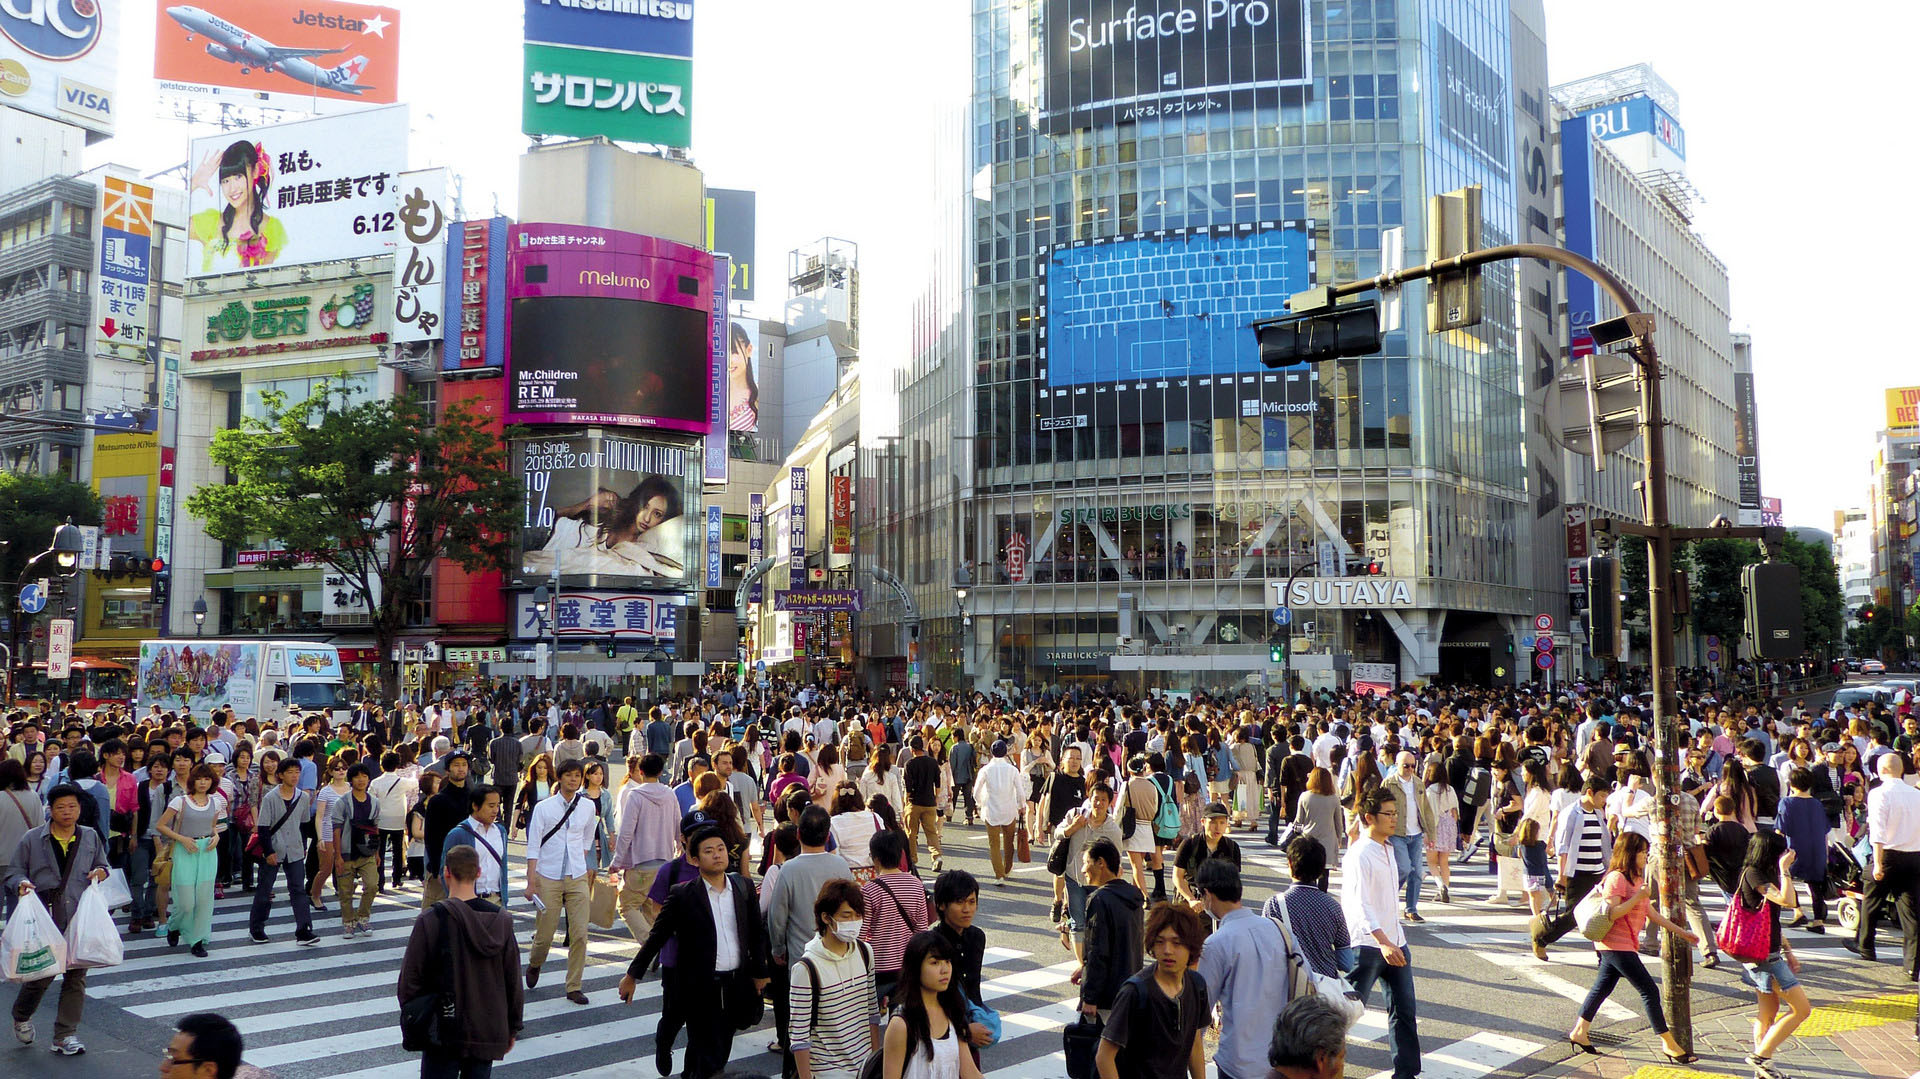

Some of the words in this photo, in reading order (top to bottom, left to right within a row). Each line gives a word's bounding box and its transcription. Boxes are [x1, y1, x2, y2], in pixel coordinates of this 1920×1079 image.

[292, 10, 365, 32] Jetstar
[541, 0, 692, 21] samitsu
[208, 16, 244, 39] Jetstar
[1069, 6, 1197, 52] Surface
[1207, 0, 1270, 30] Pro
[159, 82, 208, 94] jetstar.com
[530, 71, 686, 117] サロンパス
[64, 85, 111, 114] VISA
[1124, 98, 1223, 120] ハマる、タブレット。
[279, 150, 322, 175] 私も、
[353, 211, 395, 236] 6.12
[529, 235, 565, 246] わかさ生活
[568, 235, 606, 246] チャンネル
[395, 187, 443, 336] もんじゃ
[101, 280, 146, 302] 夜11時
[459, 224, 483, 360] 三千里薬品
[109, 299, 137, 316] まで
[121, 323, 145, 341] 地下
[252, 306, 309, 339] 西村
[519, 370, 578, 380] Mr.Children
[1263, 400, 1318, 413] Microsoft
[1899, 389, 1920, 405] TO
[1044, 419, 1072, 427] サーフェス
[1896, 407, 1920, 422] REC
[137, 441, 158, 449] KiYos
[525, 443, 540, 455] 4th
[543, 441, 570, 455] Single
[525, 453, 576, 471] 2013.6.12
[579, 452, 605, 468] OUT
[103, 495, 140, 536] 薬
[791, 471, 805, 549] 洋服の青山
[1060, 503, 1193, 524] STARBUCKS
[750, 503, 763, 584] 洋服の青
[239, 552, 266, 562] 国内旅行
[1271, 580, 1412, 605] TSUTAYA
[524, 599, 676, 630] 大盛堂書店
[51, 625, 64, 673] 道玄坂
[1046, 652, 1098, 660] STARBUCKS
